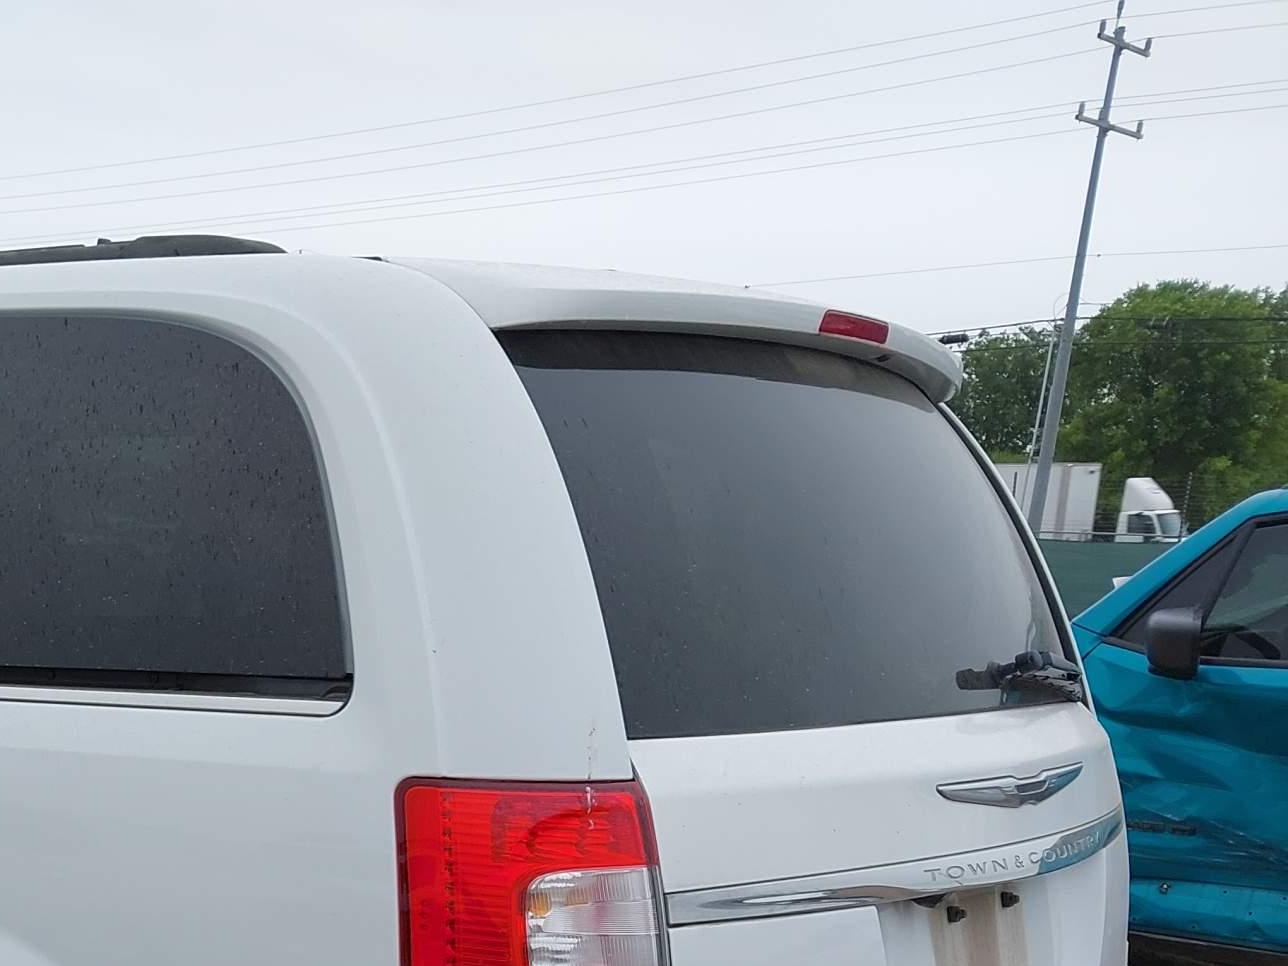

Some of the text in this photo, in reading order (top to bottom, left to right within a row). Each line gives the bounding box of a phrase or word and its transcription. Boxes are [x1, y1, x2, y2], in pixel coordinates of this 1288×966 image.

[923, 831, 1100, 881] TOWN & COUNTRY
